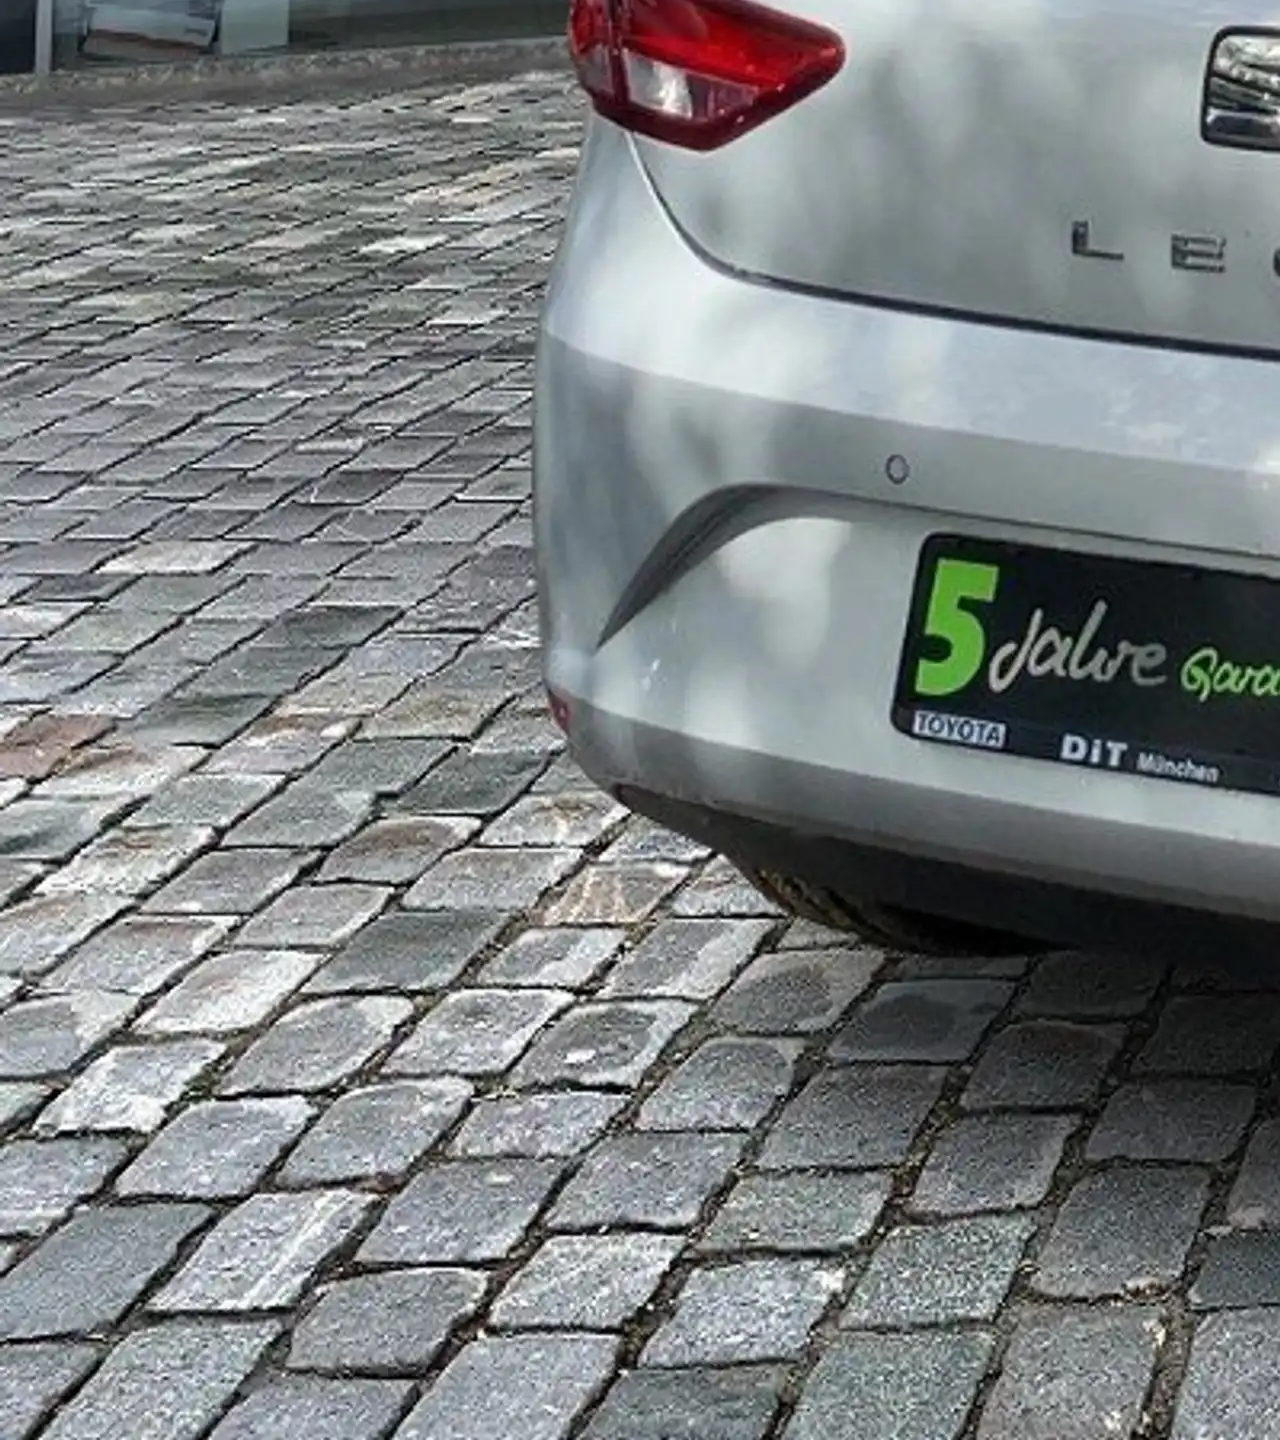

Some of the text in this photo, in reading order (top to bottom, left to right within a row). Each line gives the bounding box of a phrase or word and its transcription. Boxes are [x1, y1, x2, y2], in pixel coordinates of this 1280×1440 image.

[915, 557, 999, 696] 5
[987, 599, 1168, 694] Jahre
[915, 711, 1004, 747] TOYOTA
[1136, 751, 1220, 783] München
